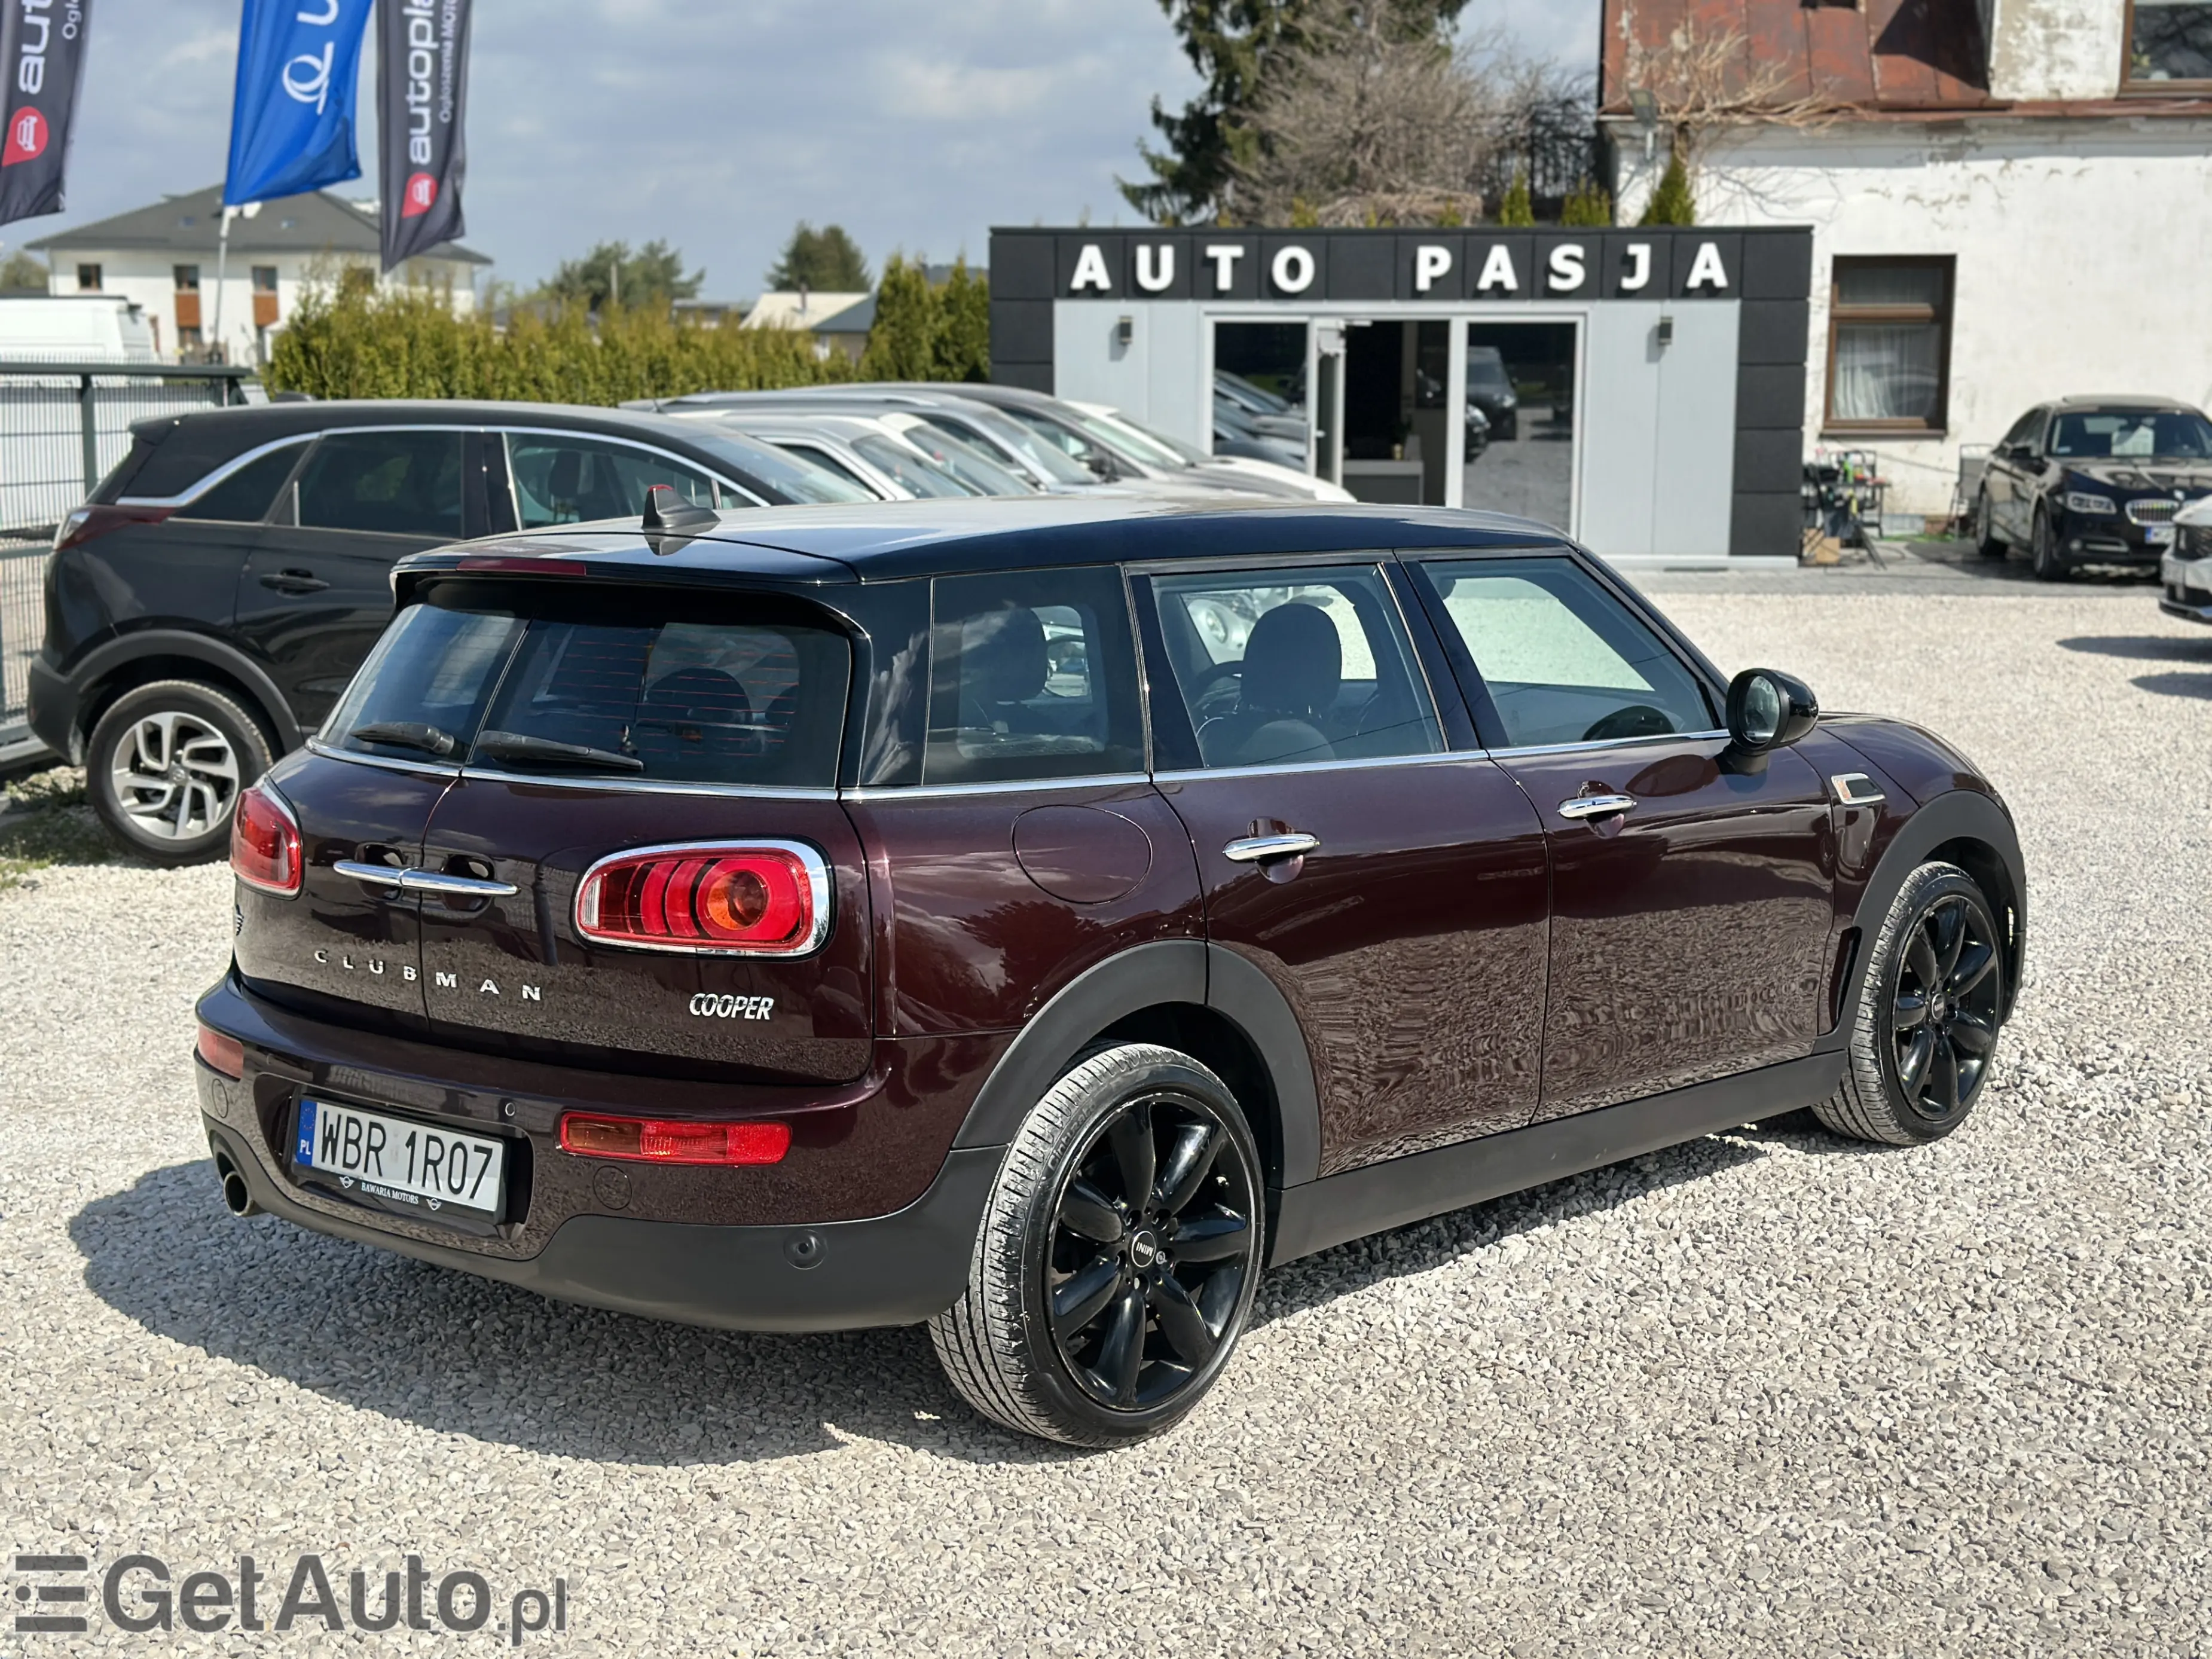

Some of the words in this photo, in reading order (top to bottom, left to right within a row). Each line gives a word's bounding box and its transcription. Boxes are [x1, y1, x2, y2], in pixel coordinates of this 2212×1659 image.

[402, 0, 439, 165] autopl
[1070, 245, 1315, 292] AUTO
[1416, 242, 1729, 291] PASJA
[314, 949, 540, 1001] CLUBMAN
[689, 993, 775, 1020] COOPER
[300, 1139, 311, 1155] PL
[321, 1111, 387, 1177] WBR
[405, 1131, 493, 1200] 1R07
[361, 1182, 390, 1197] BAWARIA
[392, 1190, 418, 1205] MOTORS
[1136, 1242, 1153, 1257] MINI
